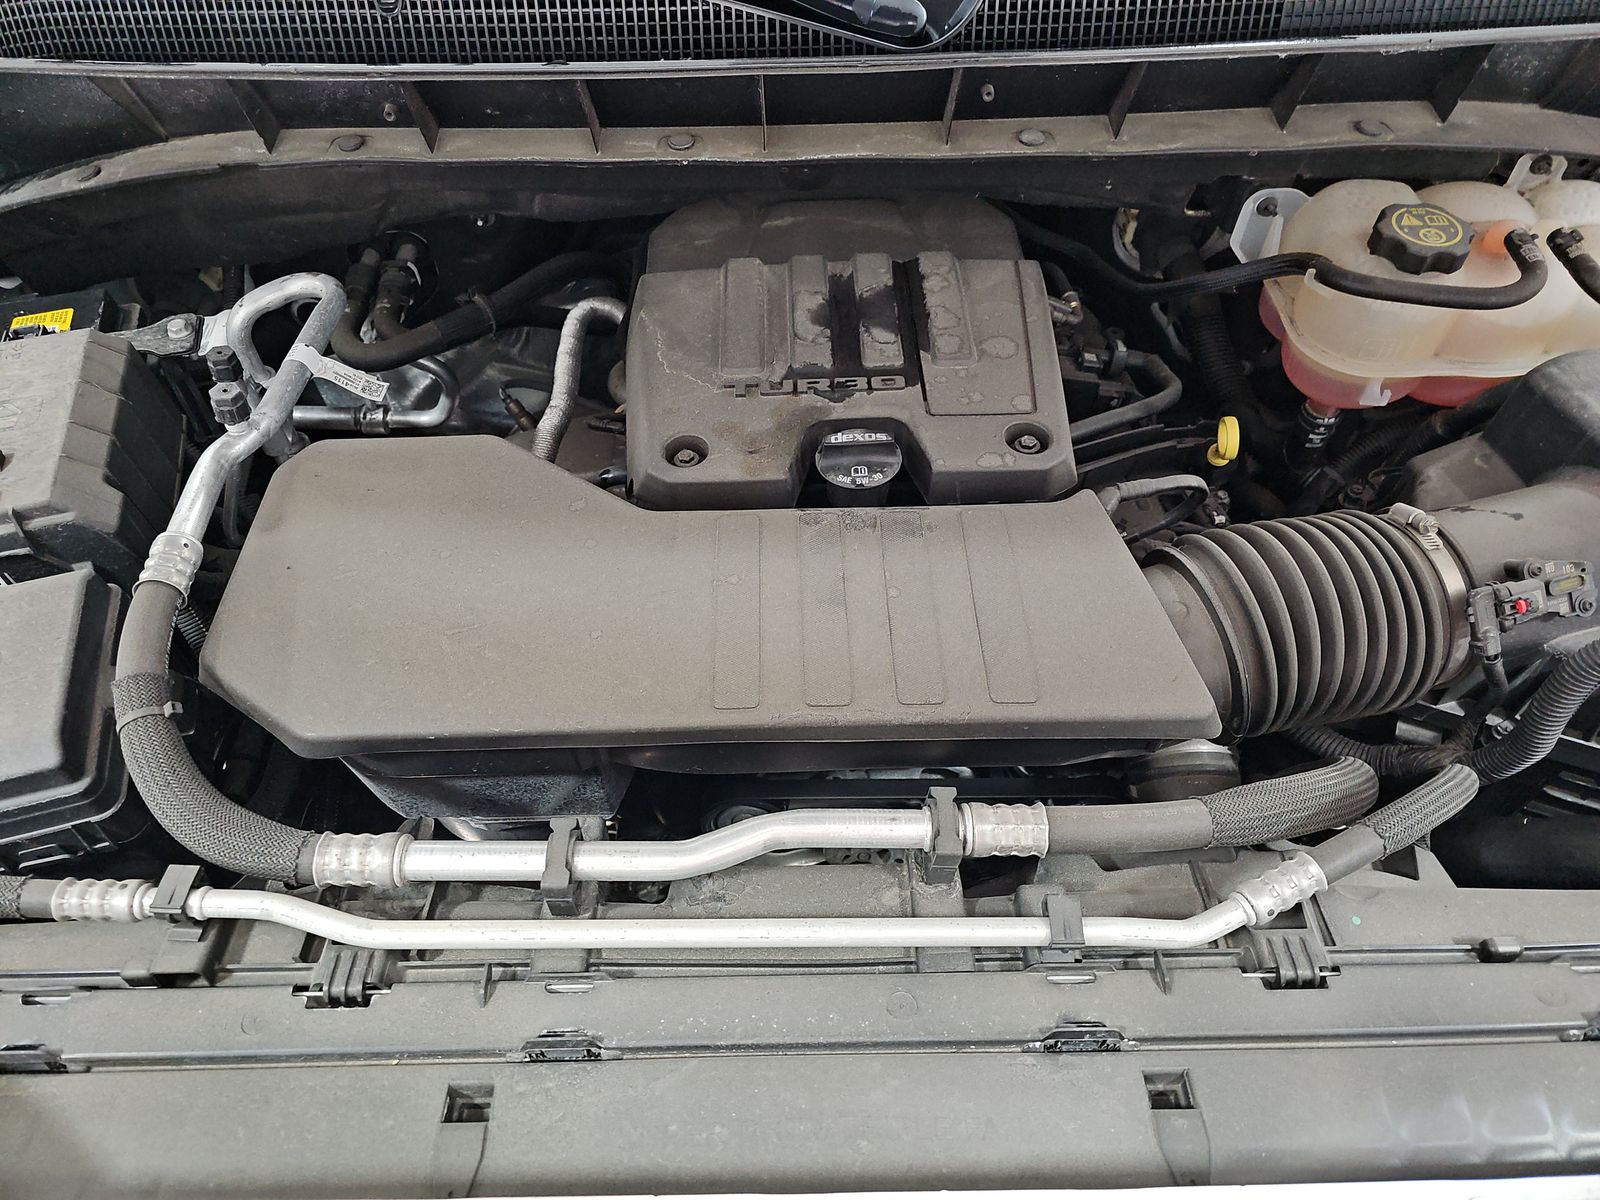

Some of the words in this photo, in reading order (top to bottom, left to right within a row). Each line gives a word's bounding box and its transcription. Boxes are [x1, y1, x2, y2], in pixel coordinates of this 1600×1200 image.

[830, 432, 887, 443] dexos
[836, 474, 852, 484] SAE
[856, 472, 883, 485] 5W-30
